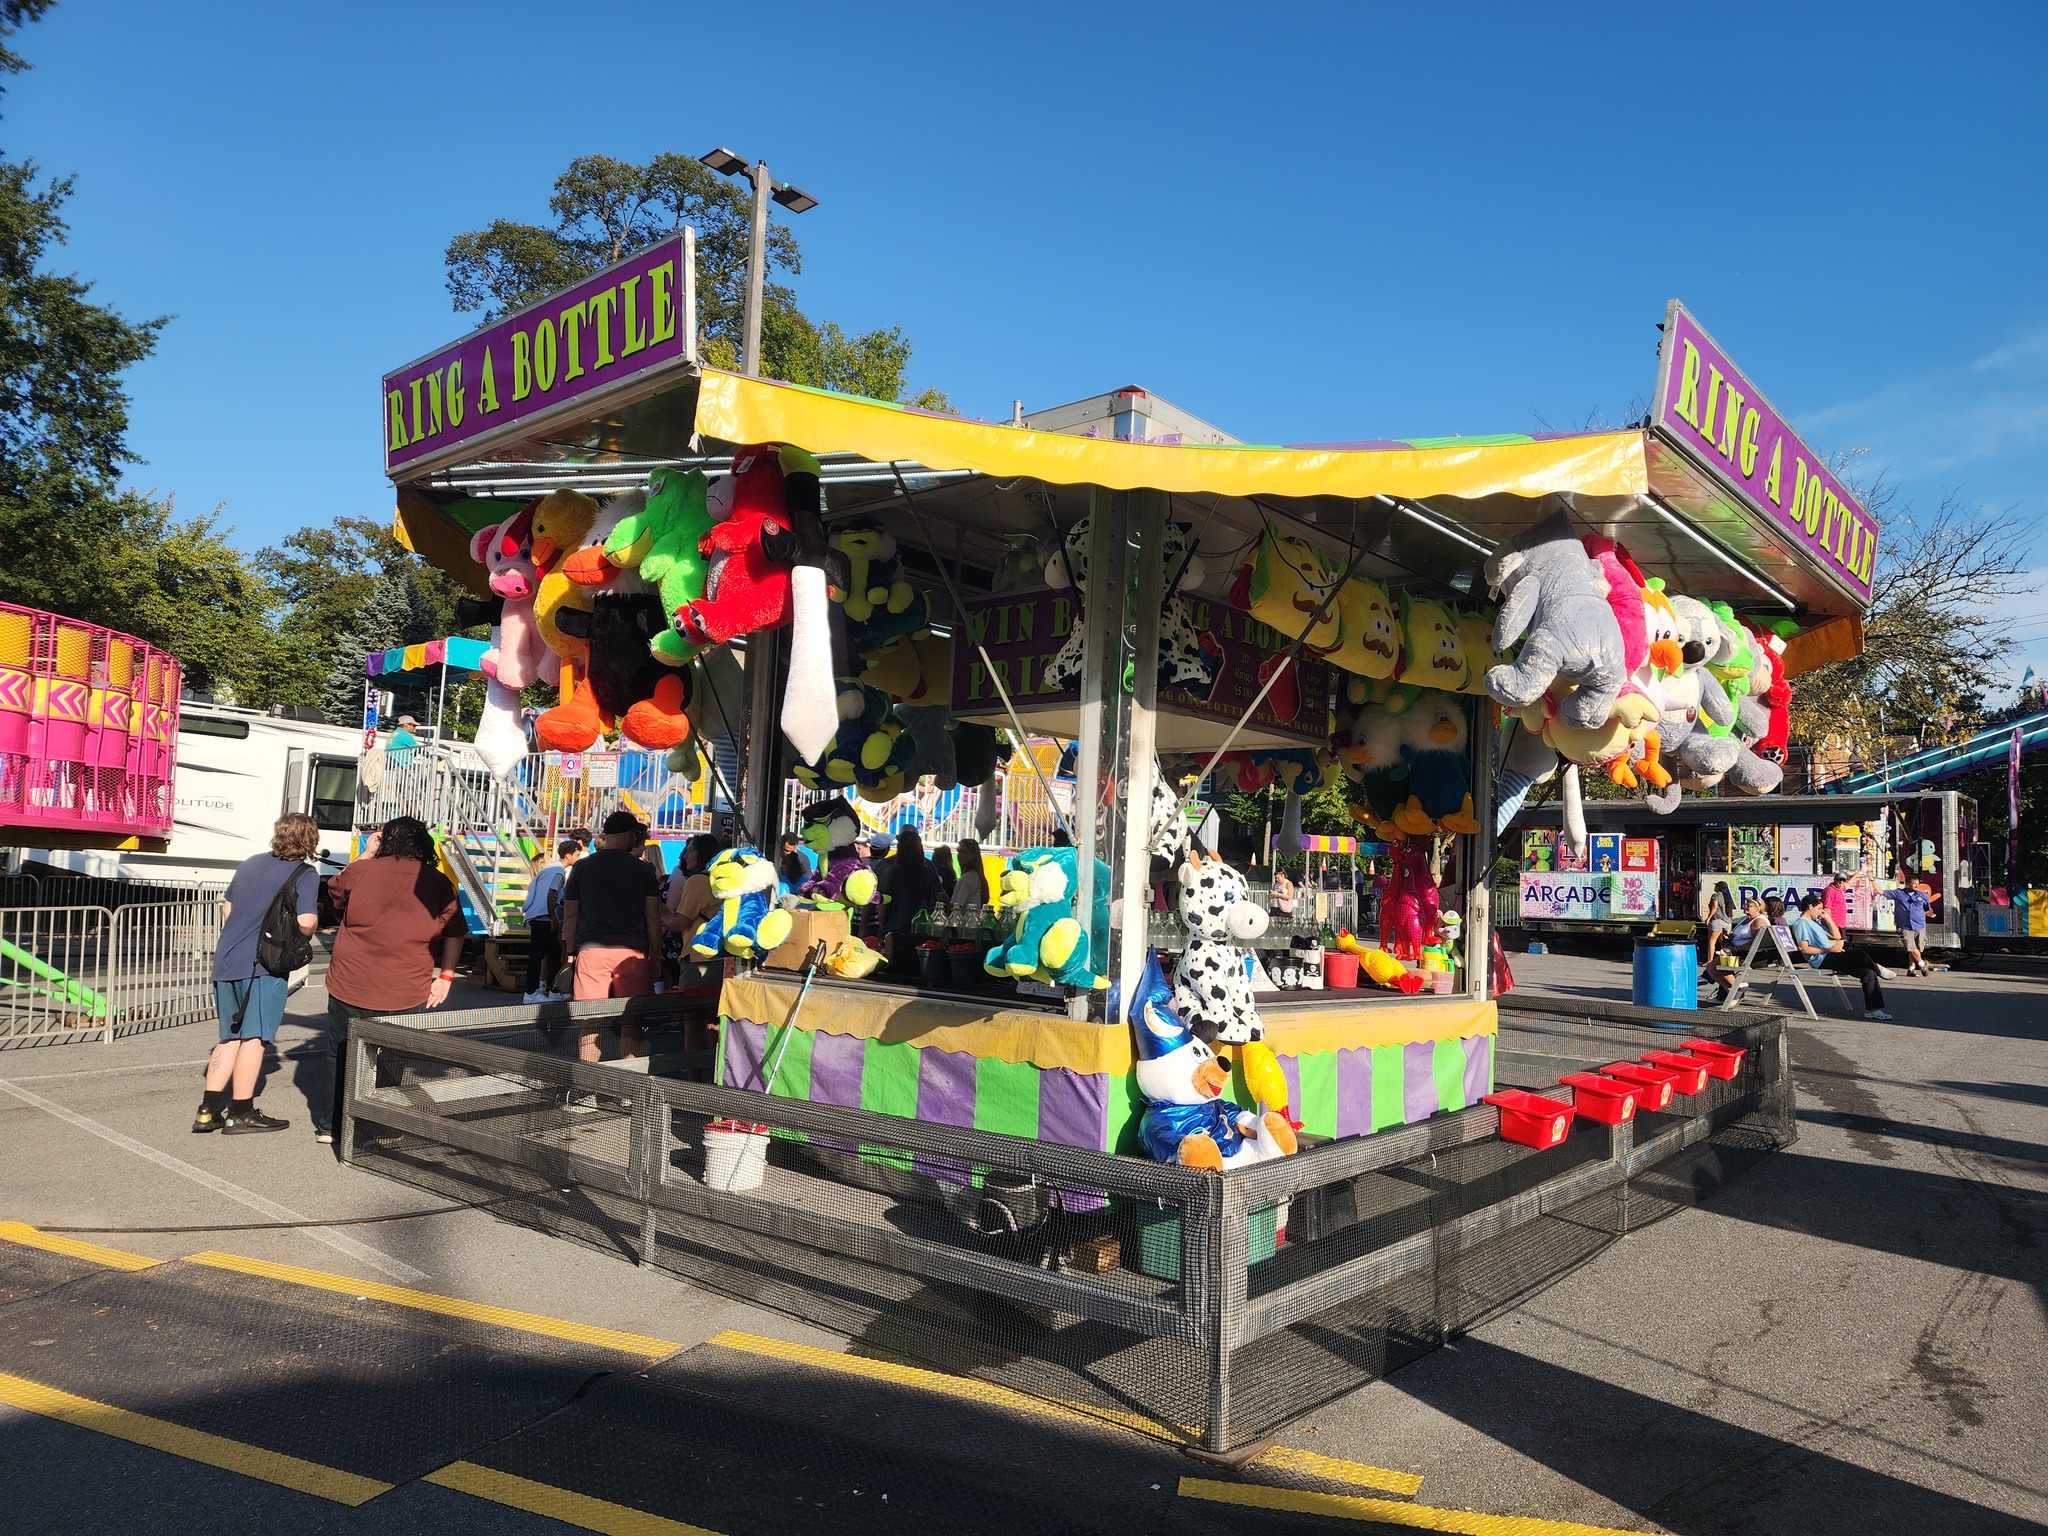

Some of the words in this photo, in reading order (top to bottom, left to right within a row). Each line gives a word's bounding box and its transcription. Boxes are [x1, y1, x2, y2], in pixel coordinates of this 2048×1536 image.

[388, 358, 465, 452] RING
[477, 345, 500, 415] A
[510, 260, 676, 402] BOTTLE
[1674, 337, 1761, 479] RING
[1765, 435, 1782, 506] A
[1789, 456, 1875, 586] BOTTLE
[965, 600, 1037, 648] WIN
[1220, 610, 1234, 640] A
[1240, 652, 1249, 664] 20
[967, 653, 1062, 701] PRIZ
[1234, 668, 1254, 685] Rings
[1234, 684, 1253, 699] $5.00
[1206, 700, 1251, 721] BOTTL
[1288, 720, 1326, 736] CHOICE
[568, 760, 574, 770] 4
[173, 797, 234, 809] OLITUDE
[1623, 877, 1643, 888] NO
[1524, 885, 1610, 904] ARCADE
